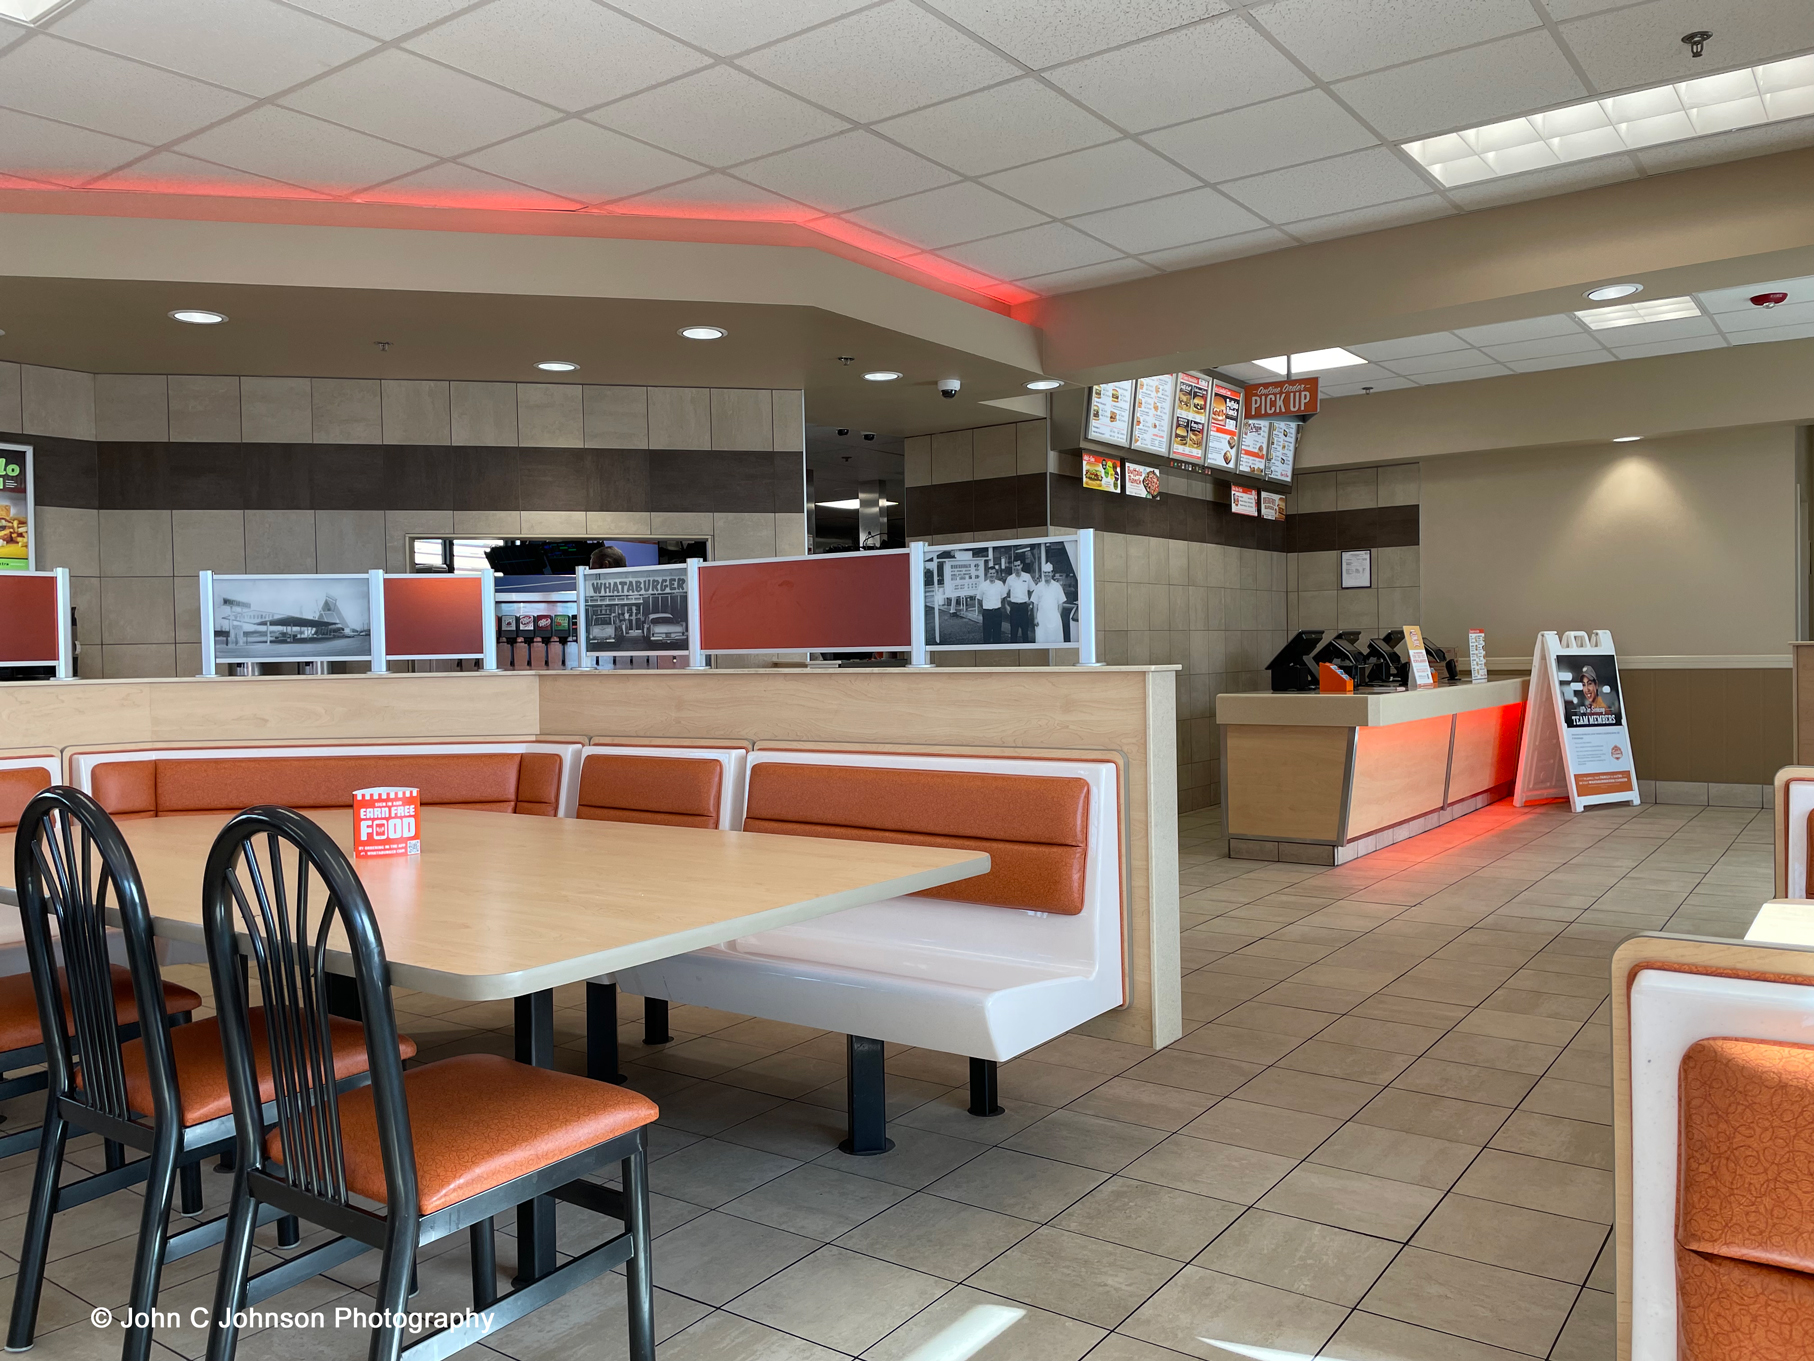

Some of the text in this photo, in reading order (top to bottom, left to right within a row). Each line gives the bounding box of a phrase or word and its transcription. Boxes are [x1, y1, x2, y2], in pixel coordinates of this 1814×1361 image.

[1258, 383, 1305, 395] Online Order
[1252, 391, 1310, 415] PICK UP
[1127, 465, 1143, 477] Buffalo
[1128, 475, 1142, 485] Ranch
[591, 577, 686, 595] WHATABURGER
[1571, 714, 1616, 725] TEAM MEMBERS
[360, 805, 415, 818] EARN FREE
[361, 817, 415, 840] FOOD
